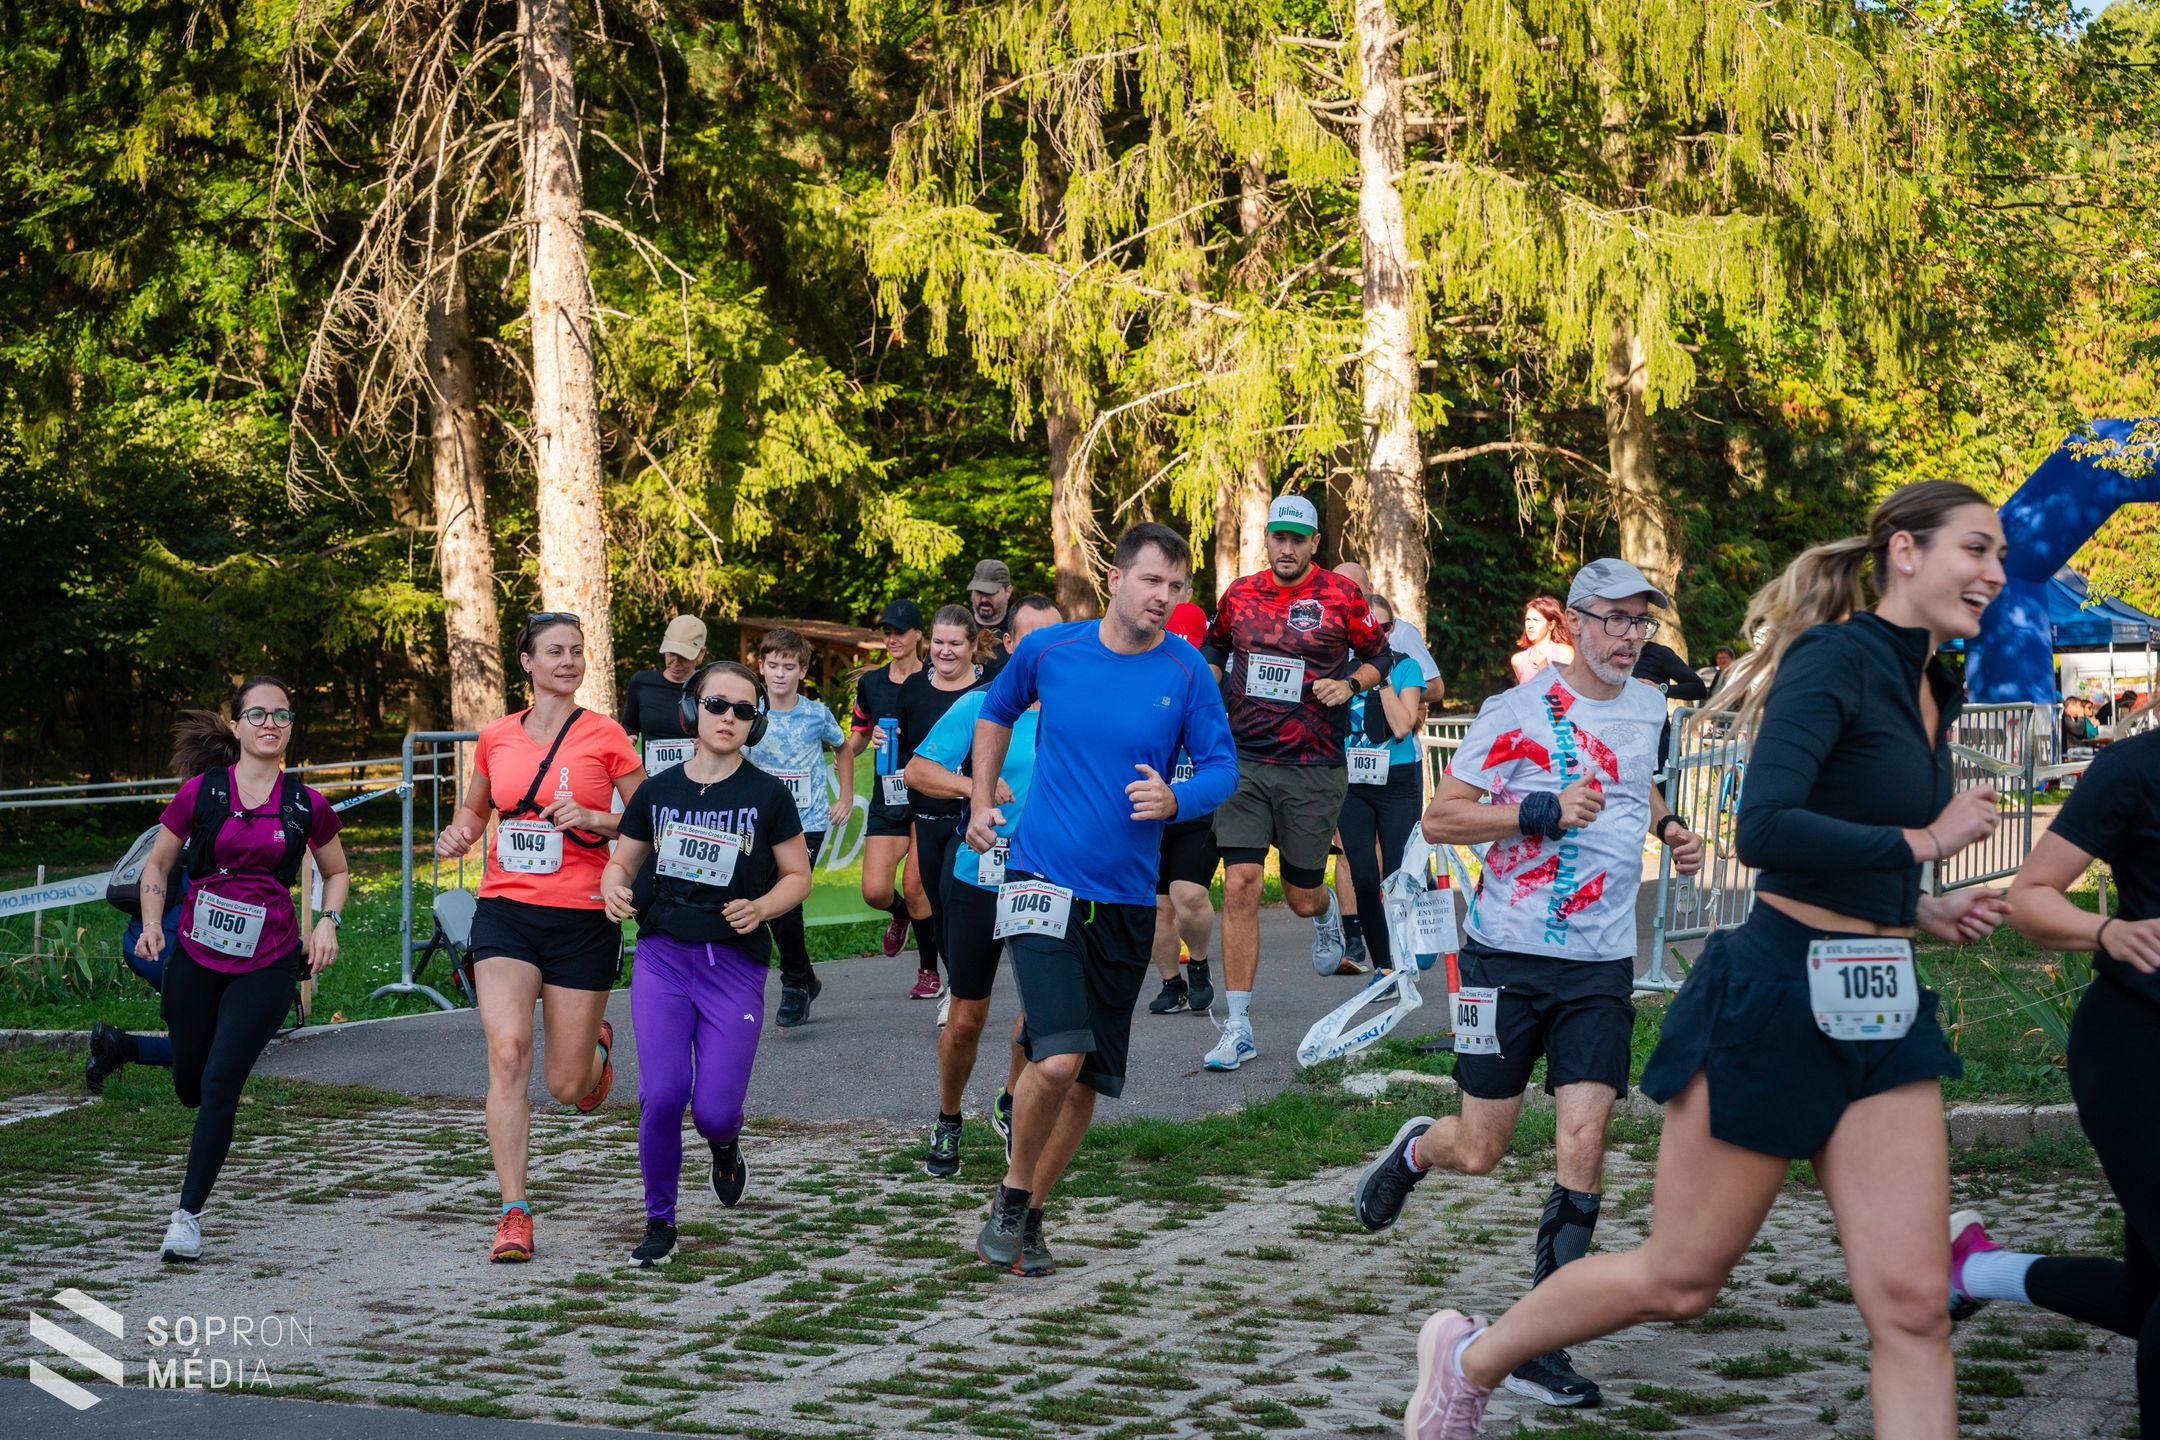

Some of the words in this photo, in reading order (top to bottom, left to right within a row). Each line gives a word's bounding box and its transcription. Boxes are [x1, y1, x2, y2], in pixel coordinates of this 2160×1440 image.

[1258, 665, 1291, 683] 5007
[656, 749, 683, 761] 1004
[1354, 757, 1377, 769] 1031
[783, 779, 799, 793] 01
[510, 832, 546, 852] 1049
[708, 831, 722, 839] Cross
[679, 837, 721, 863] 1038
[1038, 883, 1053, 891] Cross
[234, 904, 248, 912] Cross
[1011, 893, 1052, 914] 1046
[208, 908, 247, 935] 1050
[1838, 965, 1898, 999] 1053
[1457, 1003, 1479, 1028] 048
